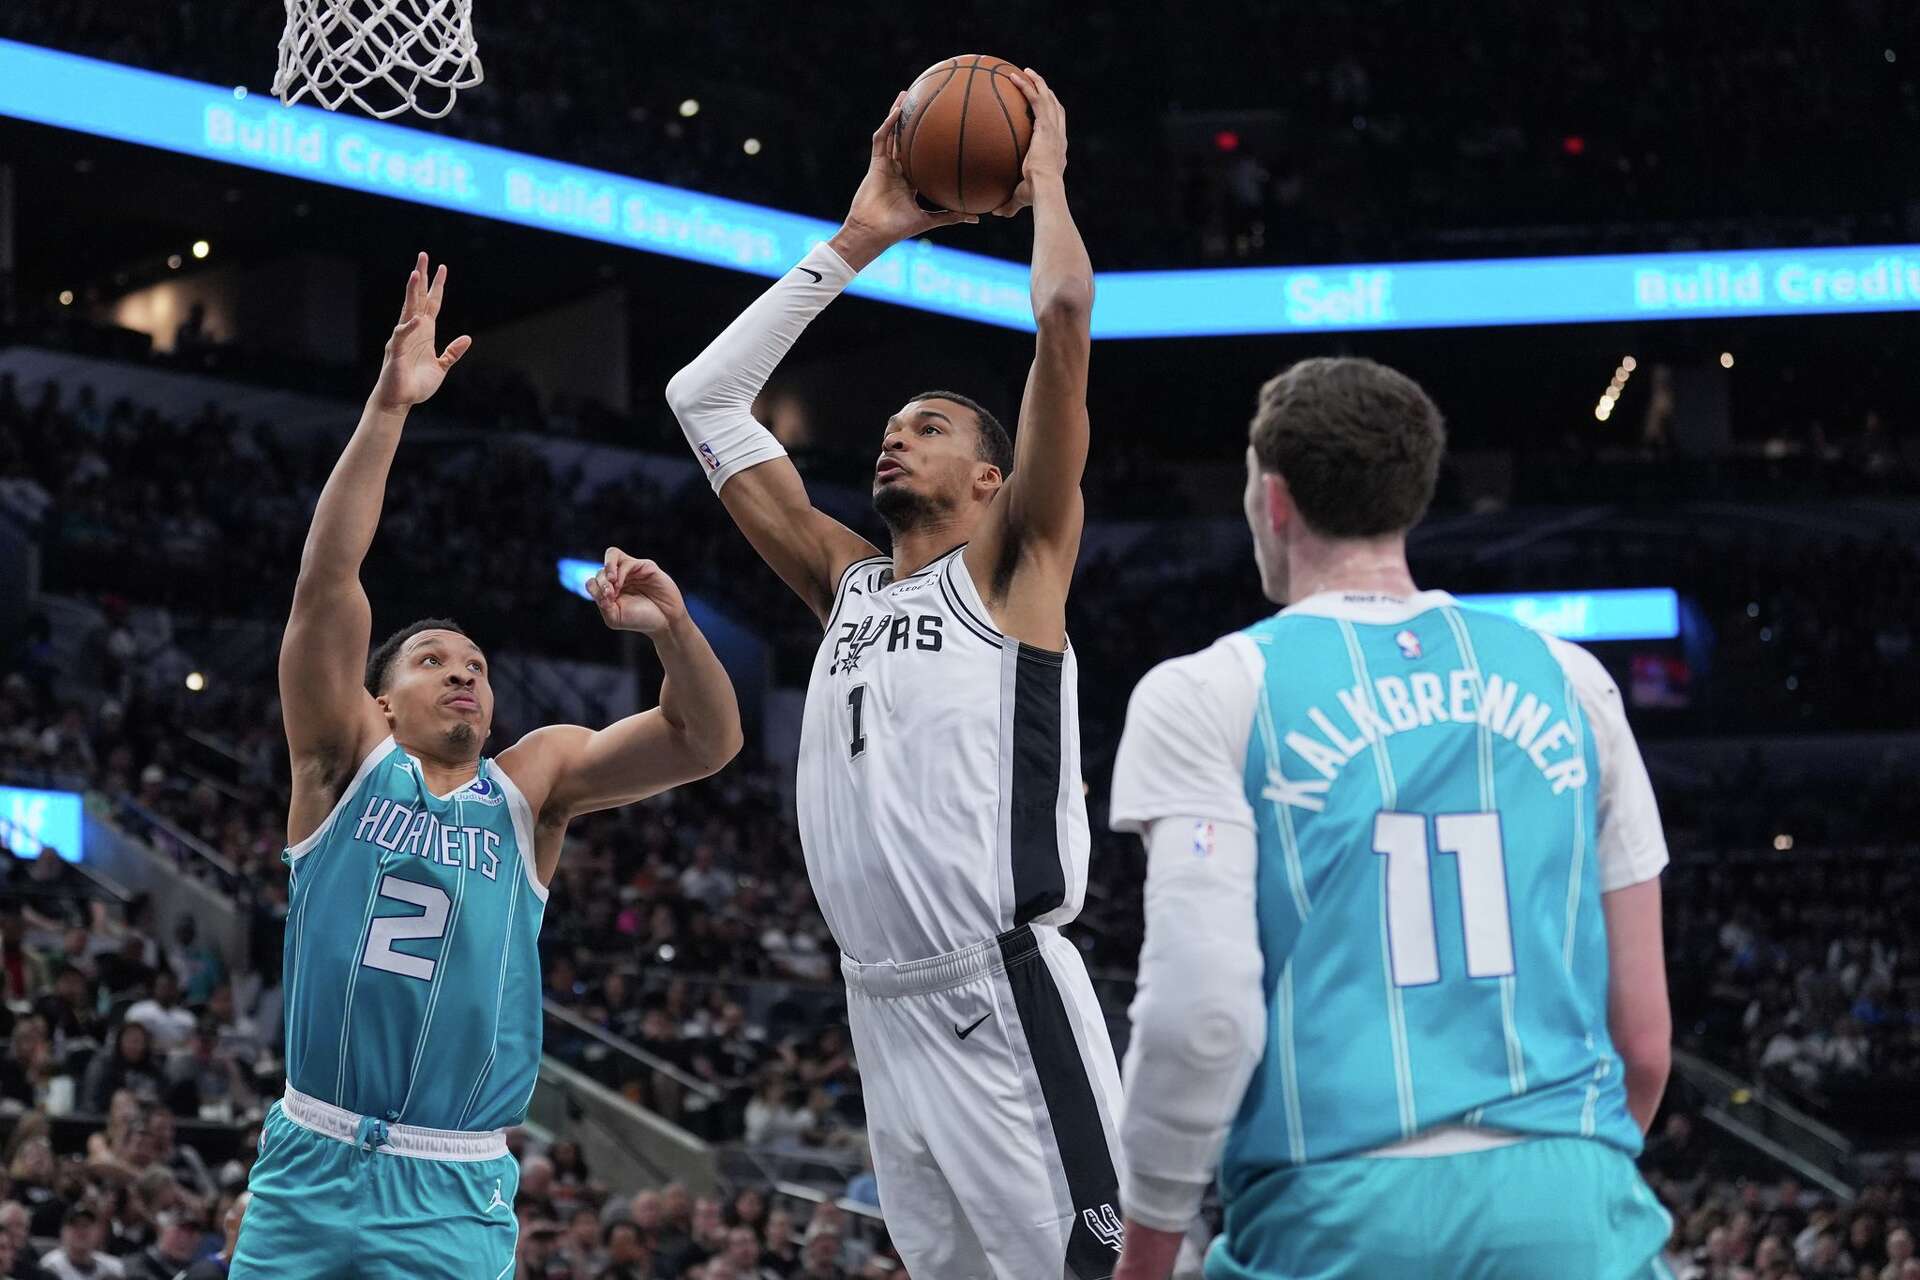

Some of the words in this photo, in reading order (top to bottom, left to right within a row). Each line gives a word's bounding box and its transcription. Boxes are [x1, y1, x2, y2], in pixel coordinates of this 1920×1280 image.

[206, 106, 323, 165] Build
[507, 169, 613, 226] Build
[1287, 272, 1391, 323] Self
[1637, 263, 1763, 307] Build
[830, 614, 943, 676] PURS
[846, 681, 867, 762] 1
[1262, 669, 1588, 813] KALKBRENNER
[353, 796, 502, 881] HORNETS
[362, 873, 453, 981] 2
[1371, 809, 1517, 988] 11
